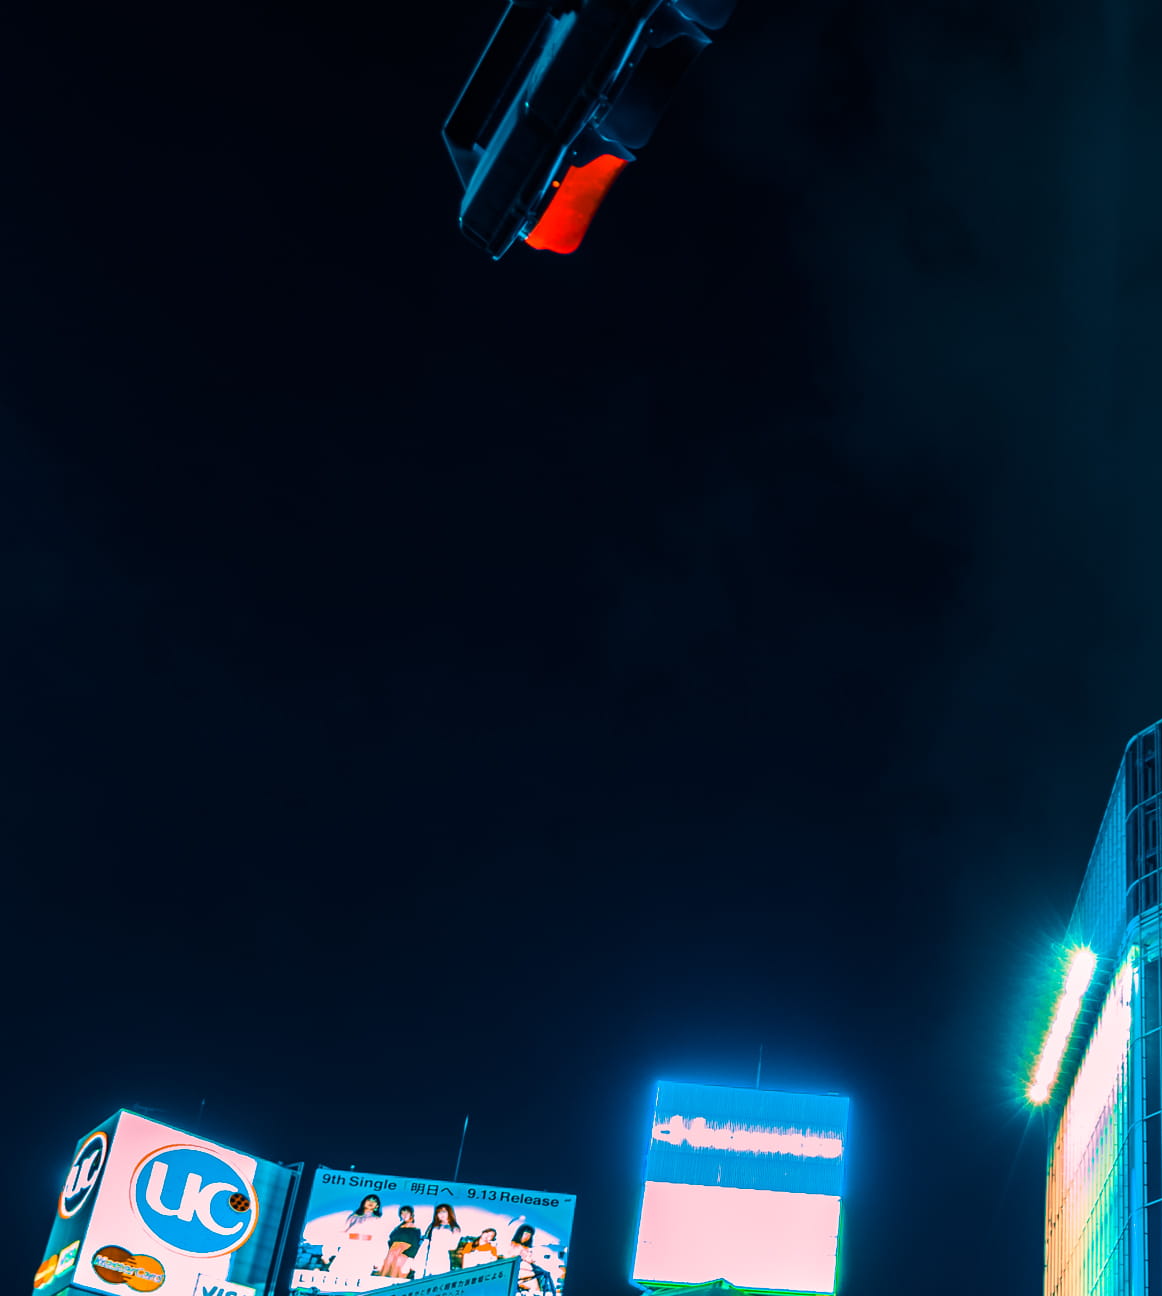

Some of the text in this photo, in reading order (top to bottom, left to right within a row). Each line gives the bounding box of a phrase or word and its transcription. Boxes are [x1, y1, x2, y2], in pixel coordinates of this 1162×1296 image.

[146, 1161, 244, 1235] UC
[321, 1173, 346, 1186] 9th
[349, 1176, 397, 1191] Single
[467, 1188, 497, 1201] 9.13
[500, 1191, 559, 1207] Release
